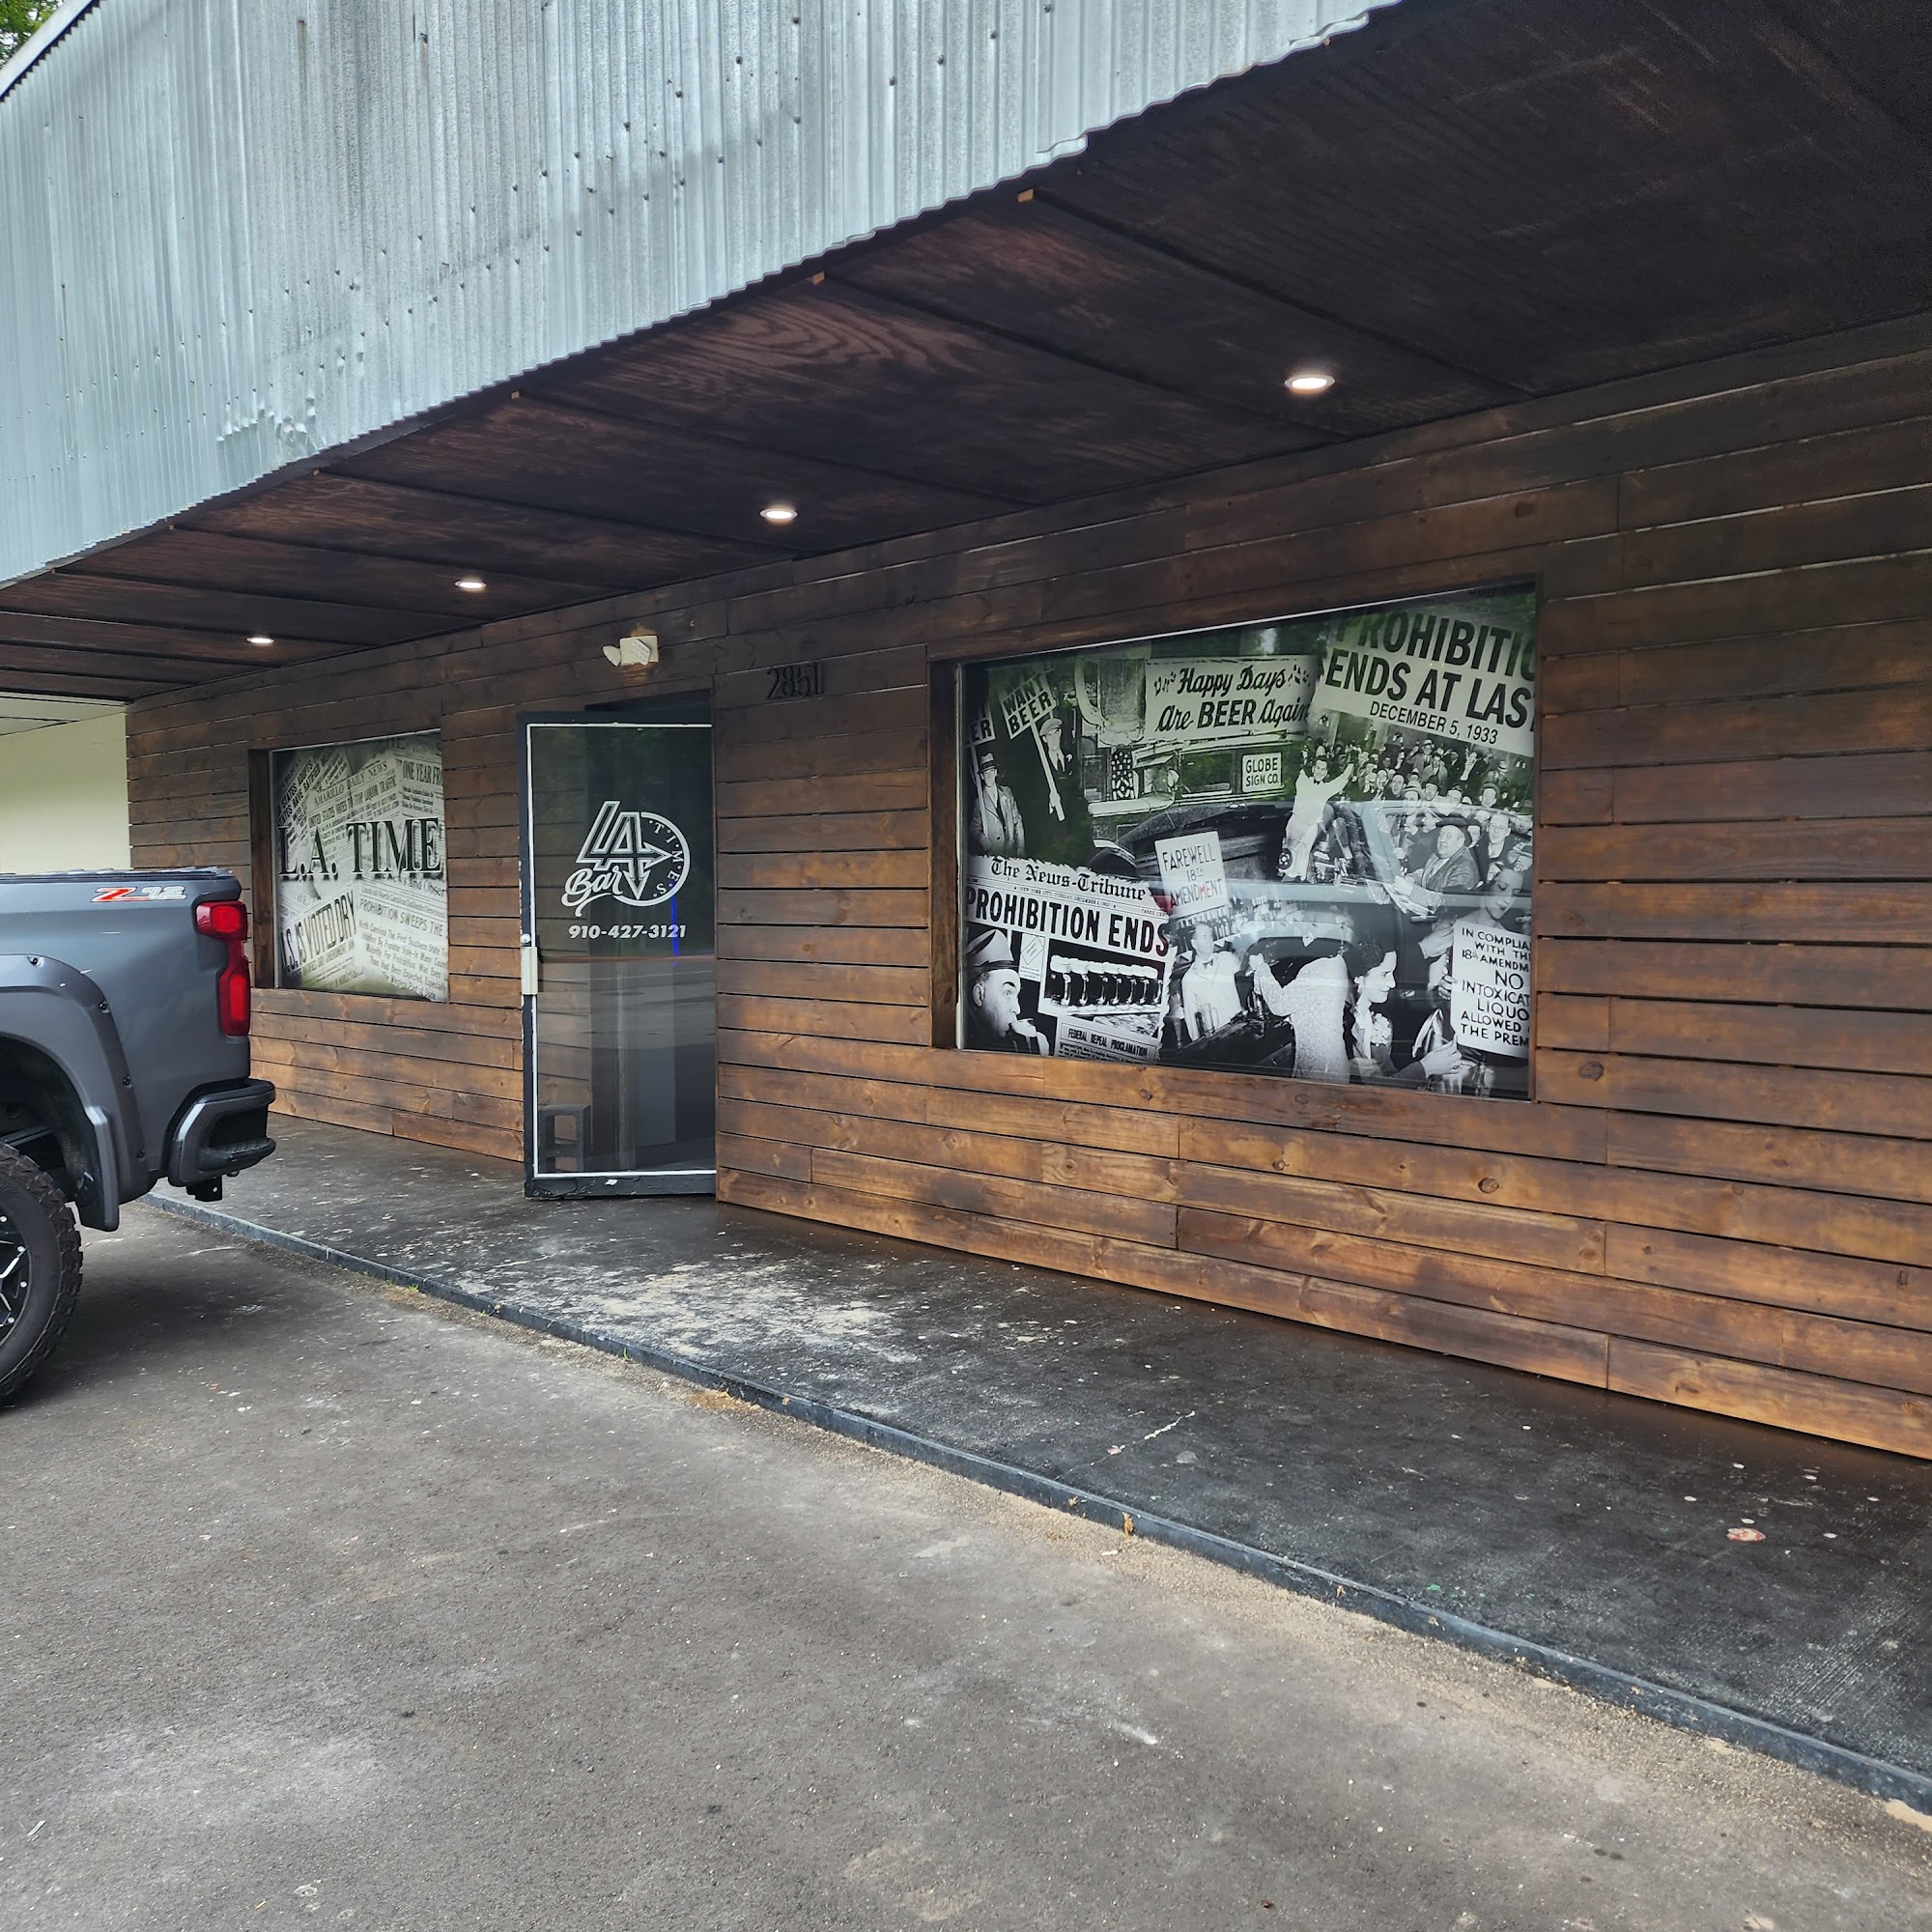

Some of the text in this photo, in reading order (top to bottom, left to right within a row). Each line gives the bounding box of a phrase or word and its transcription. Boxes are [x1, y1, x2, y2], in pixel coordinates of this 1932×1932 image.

[1002, 673, 1045, 717] WANT
[1177, 665, 1287, 697] Happy Days
[1324, 647, 1535, 733] ENDS AT LAS
[1008, 691, 1052, 735] BEER
[1197, 698, 1258, 729] BEER
[1258, 696, 1309, 728] Again
[1370, 701, 1498, 745] DECEMBER 5, 1933
[367, 760, 387, 777] NEWS
[1246, 757, 1278, 774] GLOBE
[1246, 775, 1265, 787] SIGN
[277, 825, 338, 875] L.A.
[346, 817, 442, 873] TIME
[1162, 843, 1216, 871] FAREWELL
[561, 865, 623, 917] Bar
[991, 856, 1146, 901] The News-Tribune
[1170, 878, 1223, 907] AMENDMENT
[400, 912, 428, 931] SWEEPS
[430, 921, 443, 937] THE
[568, 924, 687, 939] 910-427-3121
[967, 885, 1170, 957] PROHIBITION ENDS
[1462, 927, 1474, 938] IN
[1475, 941, 1505, 956] WITH
[1495, 969, 1524, 990] NO
[1461, 1010, 1521, 1033] ALLOWED
[1477, 998, 1530, 1022] LIQUO
[1068, 1028, 1088, 1042] FEDERAL
[1091, 1033, 1108, 1047] REPEAL
[1112, 1038, 1149, 1058] PROCLAMATION
[1461, 1023, 1489, 1039] THE
